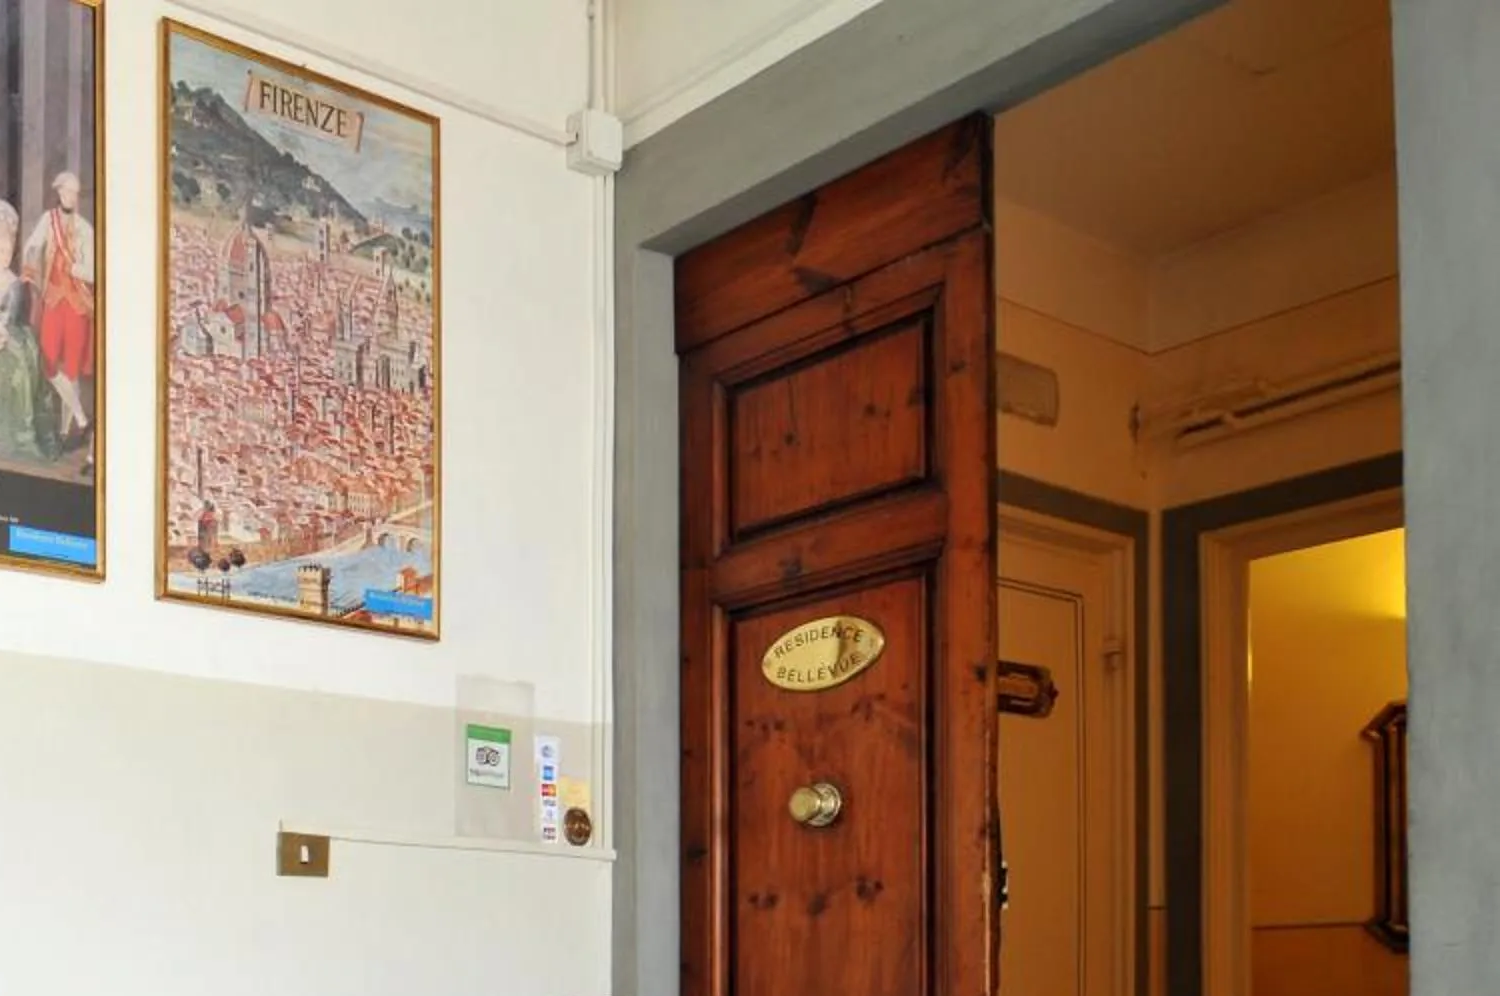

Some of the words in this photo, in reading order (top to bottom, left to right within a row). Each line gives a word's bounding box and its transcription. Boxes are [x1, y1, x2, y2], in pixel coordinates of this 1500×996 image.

[259, 81, 349, 138] FIRENZE
[773, 623, 865, 660] RESIDENCE
[776, 653, 863, 684] BELLEVUE
